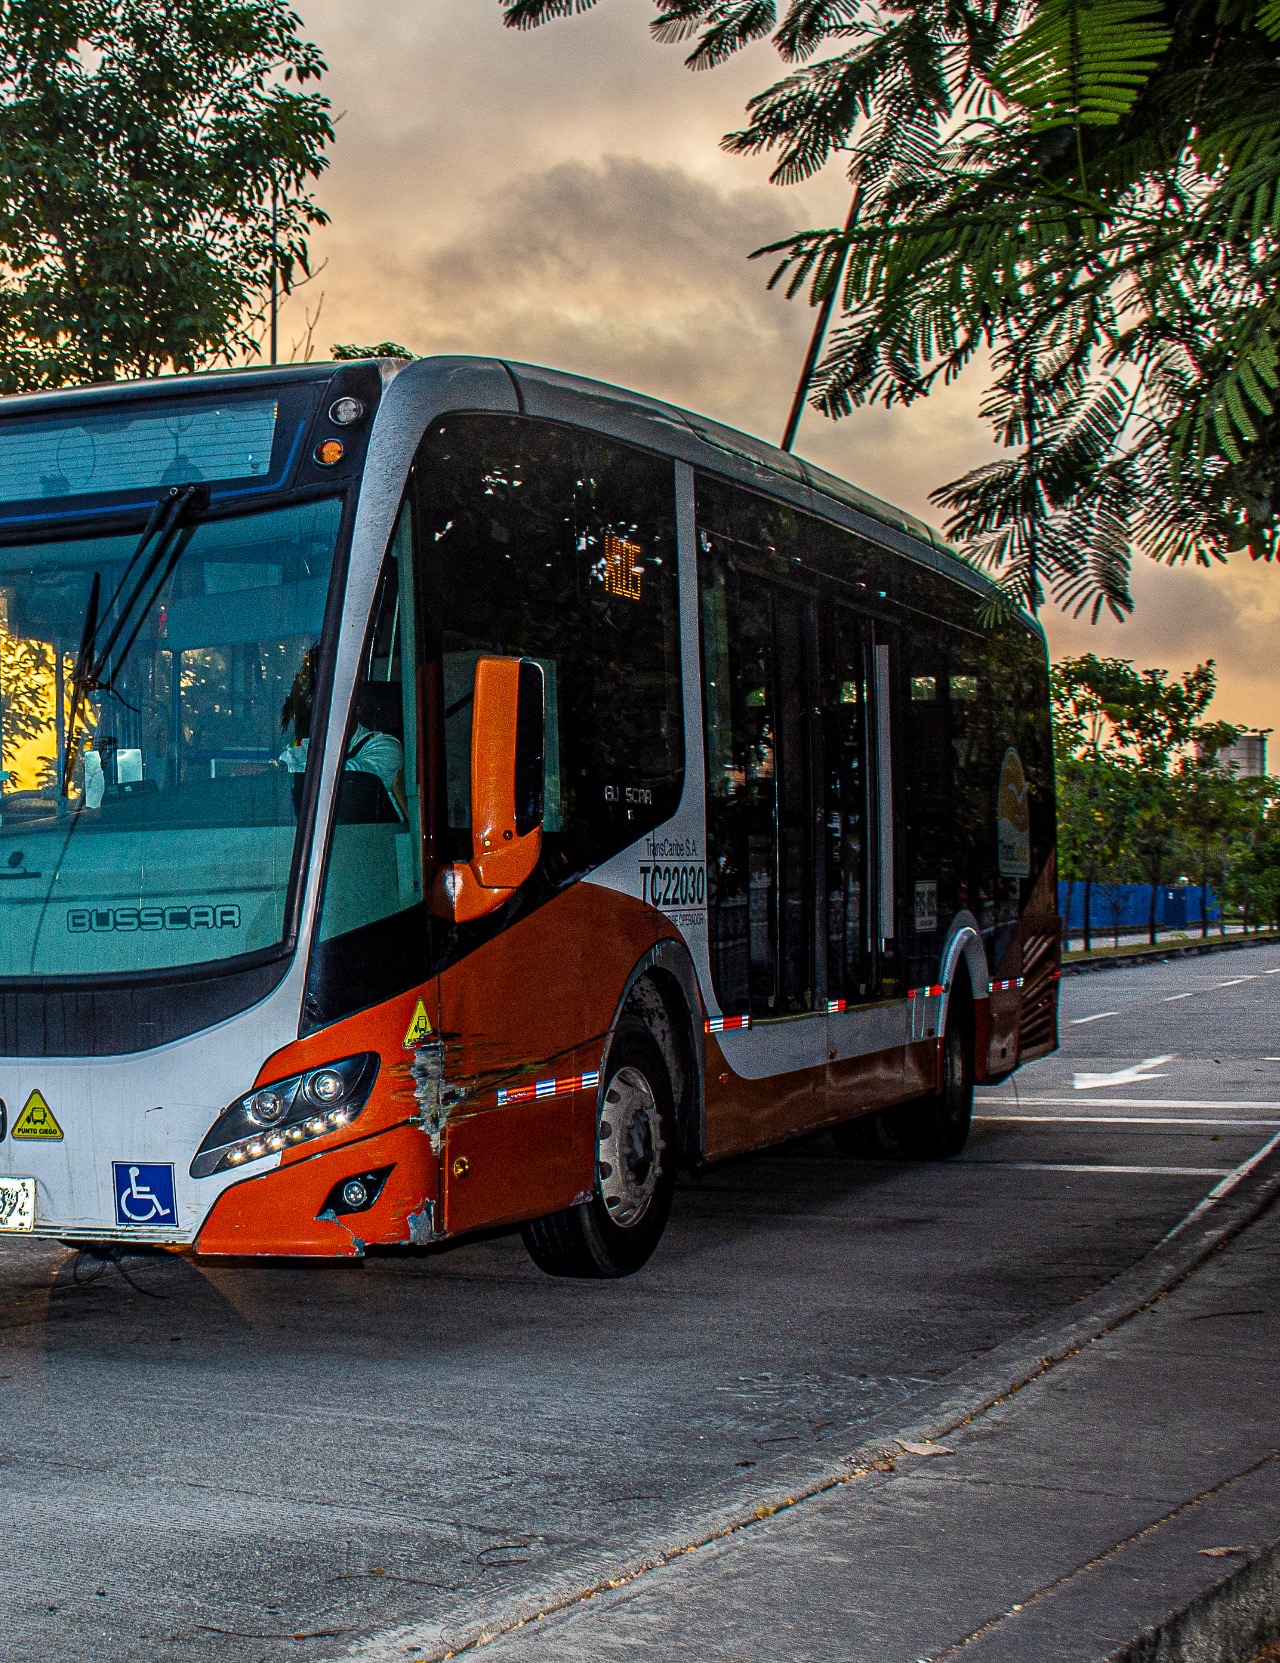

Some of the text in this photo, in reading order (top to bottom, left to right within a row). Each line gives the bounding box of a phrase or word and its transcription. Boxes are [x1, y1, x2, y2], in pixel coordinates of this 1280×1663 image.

[604, 785, 652, 805] BUSCAR
[639, 865, 705, 907] TC22030
[67, 904, 241, 933] BUSSCAR
[17, 1127, 38, 1135] PUNTO
